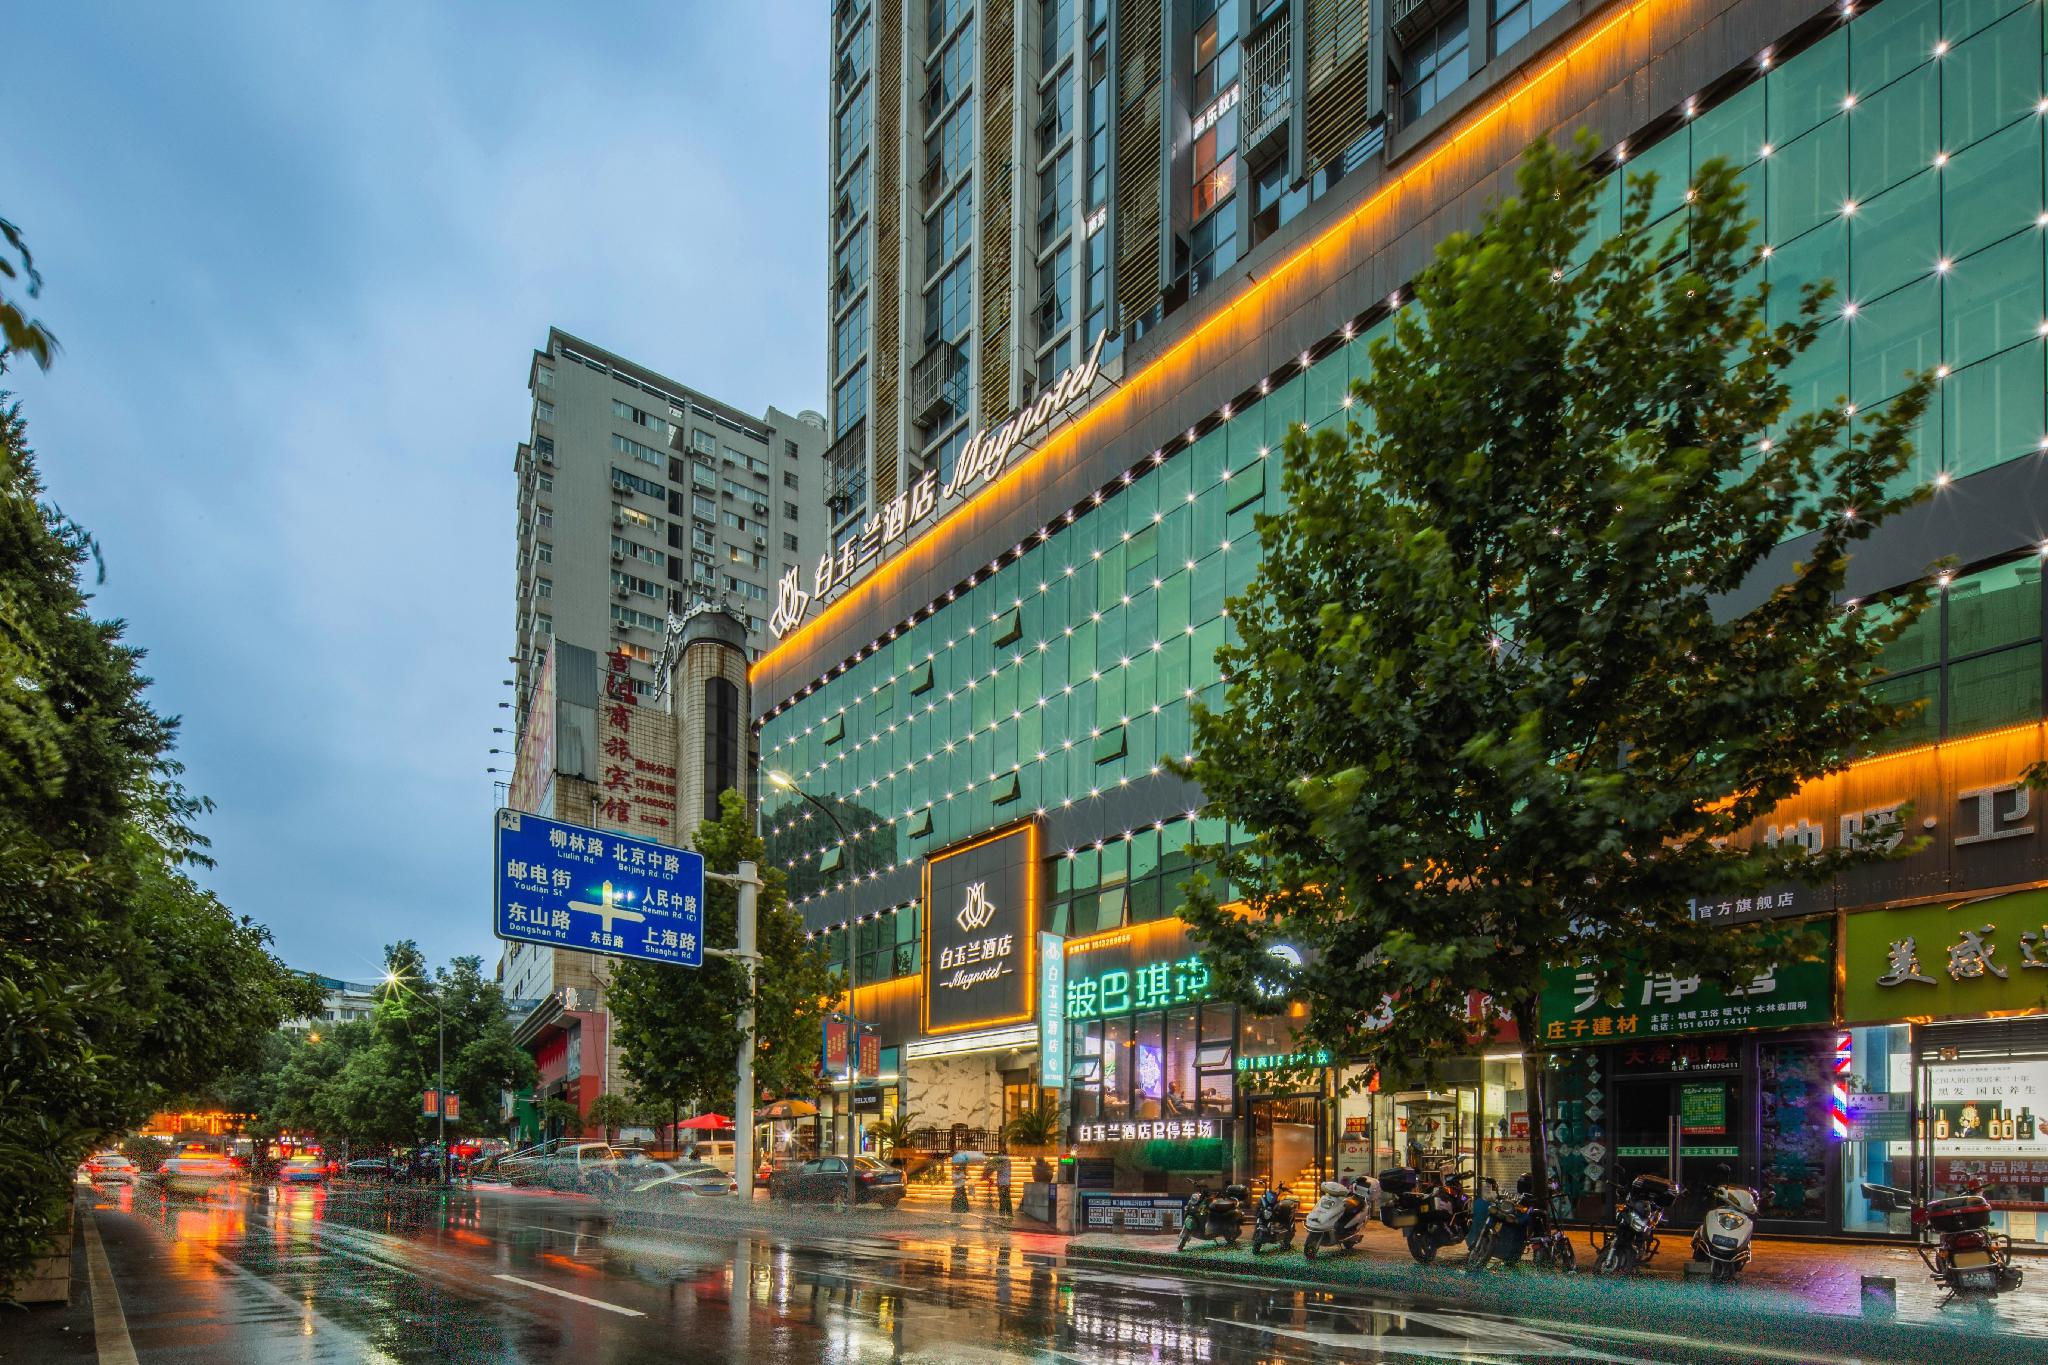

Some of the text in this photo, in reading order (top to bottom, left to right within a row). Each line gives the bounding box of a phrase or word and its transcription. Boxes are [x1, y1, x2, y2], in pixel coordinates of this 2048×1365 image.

[943, 328, 1108, 500] Magnotel
[815, 469, 938, 600] 白玉兰酒店
[549, 828, 604, 858] 柳林路
[612, 843, 680, 874] 北京中路
[618, 863, 646, 877] Beijing
[507, 859, 572, 889] 邮电街
[514, 881, 549, 894] Youdian
[642, 887, 697, 914] 人民中路
[507, 902, 571, 931] 东山路
[642, 905, 669, 917] Renmin
[1699, 892, 1794, 918] 官方旗舰店
[509, 923, 552, 937] Dongshan
[590, 931, 624, 949] 东岳路
[642, 927, 697, 952] 上海路
[645, 946, 678, 957] Shanghai
[940, 935, 1013, 970] 白玉兰酒店
[950, 962, 1002, 990] Magnotel
[1573, 960, 1780, 1014] 天净
[1047, 965, 1058, 1053] 白玉兰酒店
[1678, 1011, 1697, 1021] 地暖
[1700, 1009, 1719, 1018] 卫浴
[1722, 1006, 1752, 1016] 暖气片
[1546, 1014, 1639, 1040] 庄子建材
[1650, 1016, 1748, 1032] 电话： 151 6107 5411
